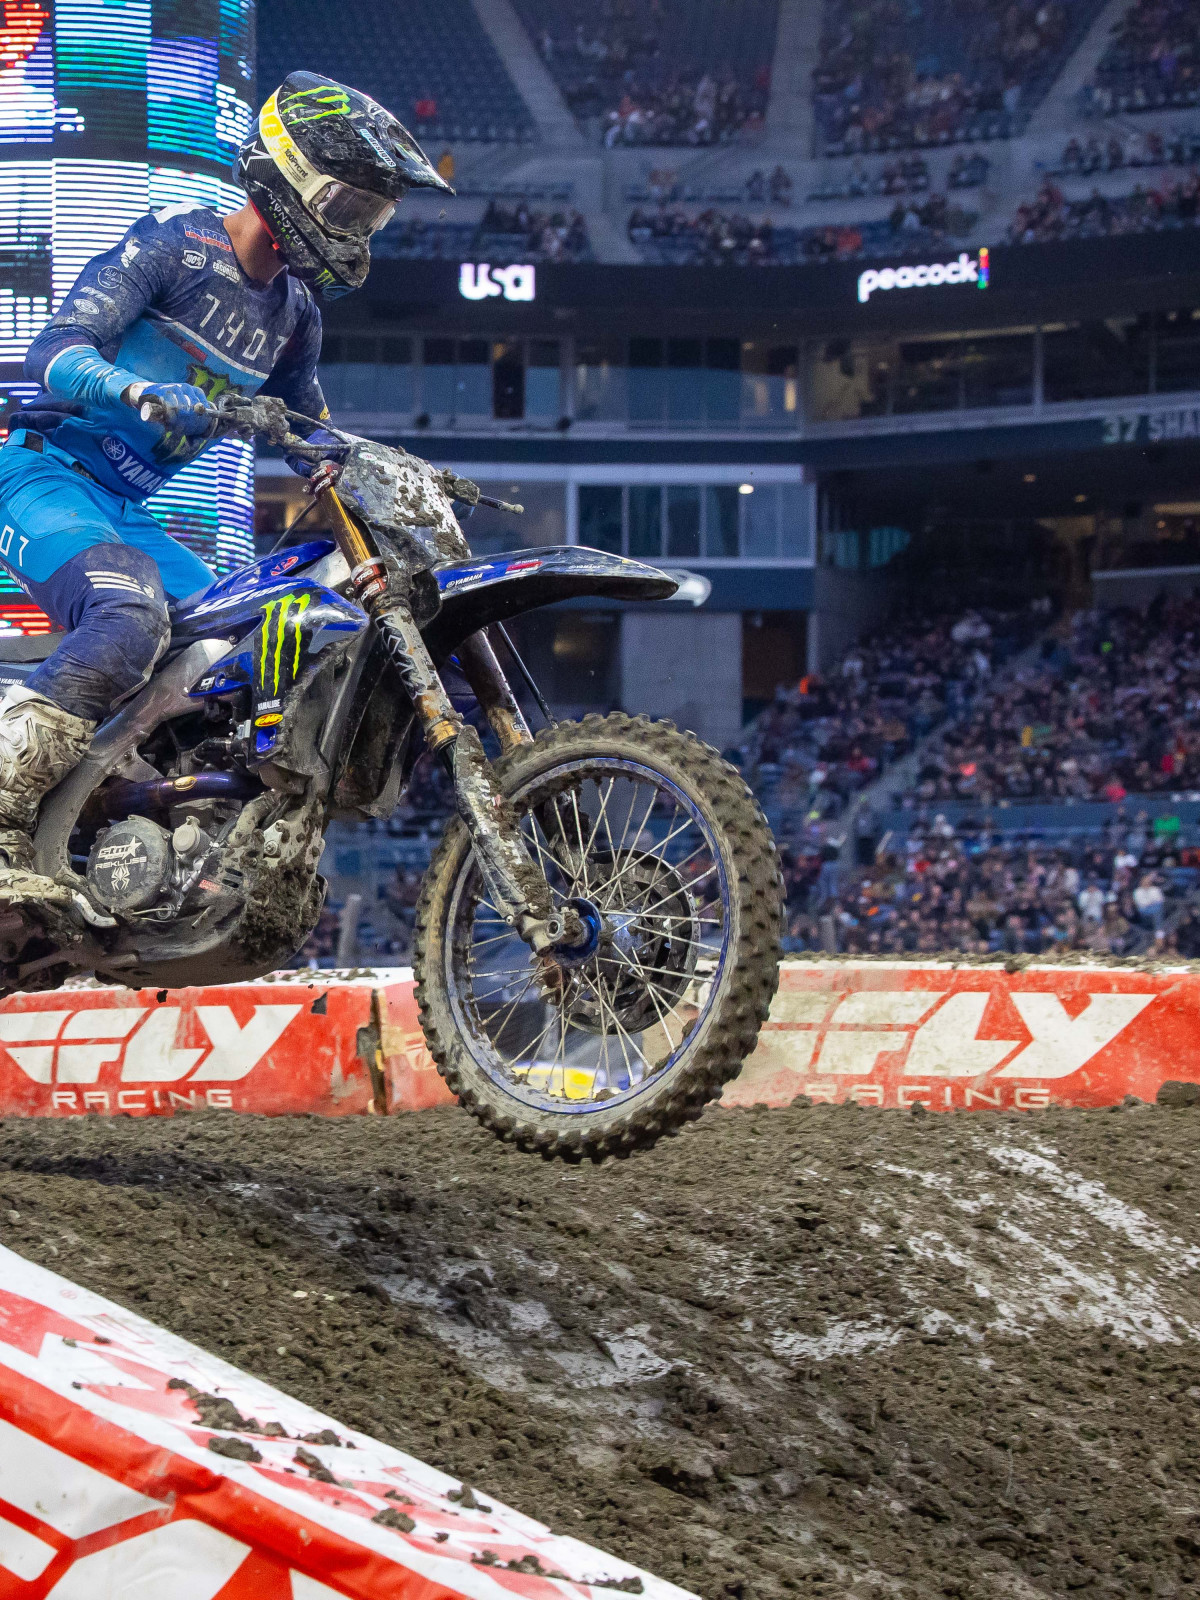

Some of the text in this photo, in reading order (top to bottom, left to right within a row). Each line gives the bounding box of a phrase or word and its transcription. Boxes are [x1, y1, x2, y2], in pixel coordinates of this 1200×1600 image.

[857, 252, 979, 303] peacock
[762, 990, 1158, 1080] FLY
[51, 1088, 233, 1110] RACING
[804, 1082, 1050, 1109] RACING
